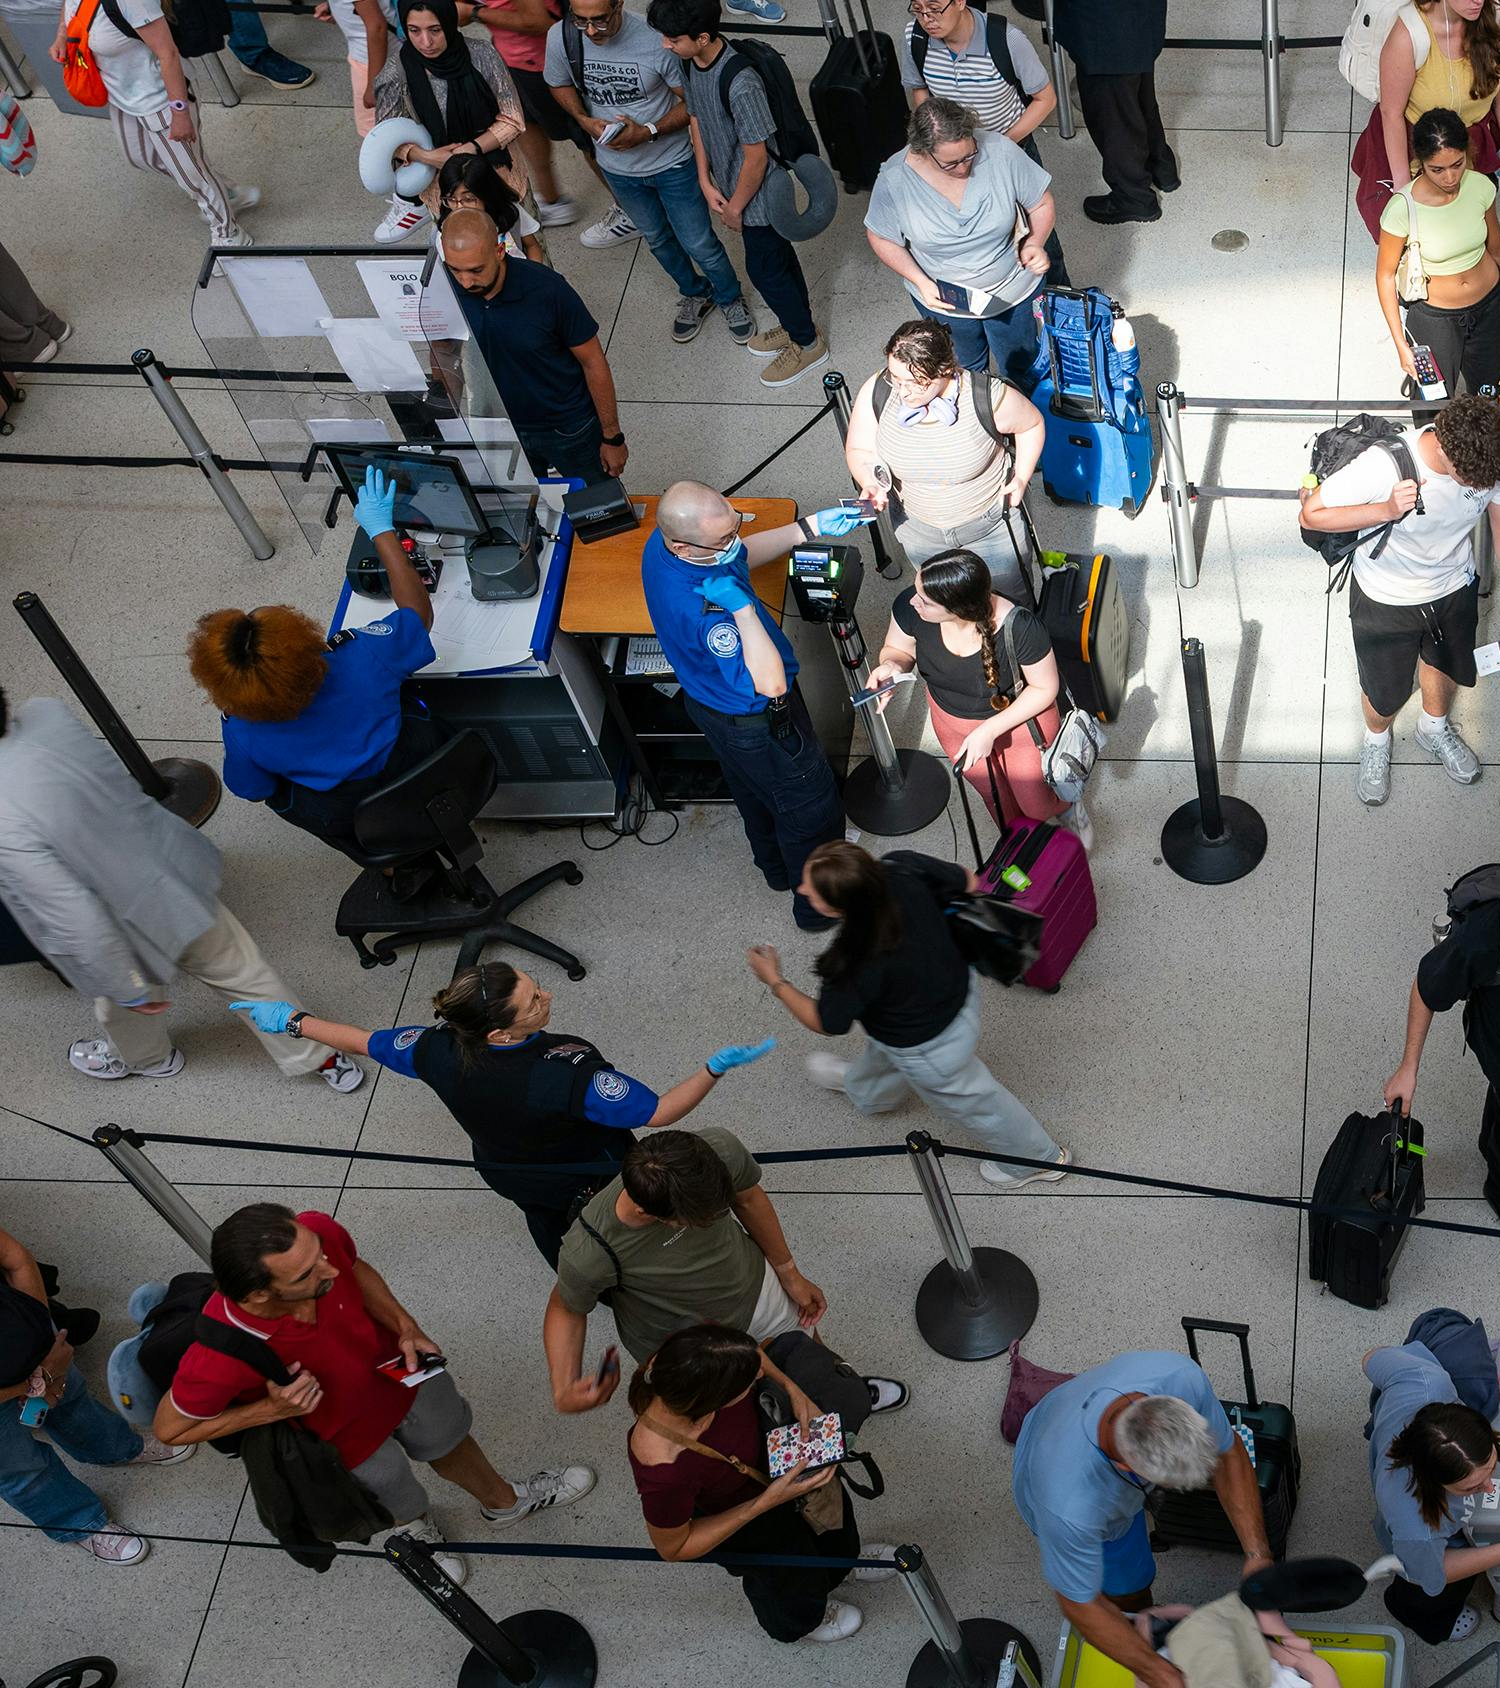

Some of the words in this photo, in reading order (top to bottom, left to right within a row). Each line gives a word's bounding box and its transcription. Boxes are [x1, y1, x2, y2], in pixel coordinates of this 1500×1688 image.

[584, 63, 616, 74] STRAUSS
[618, 67, 625, 75] &
[389, 273, 418, 281] BOLO
